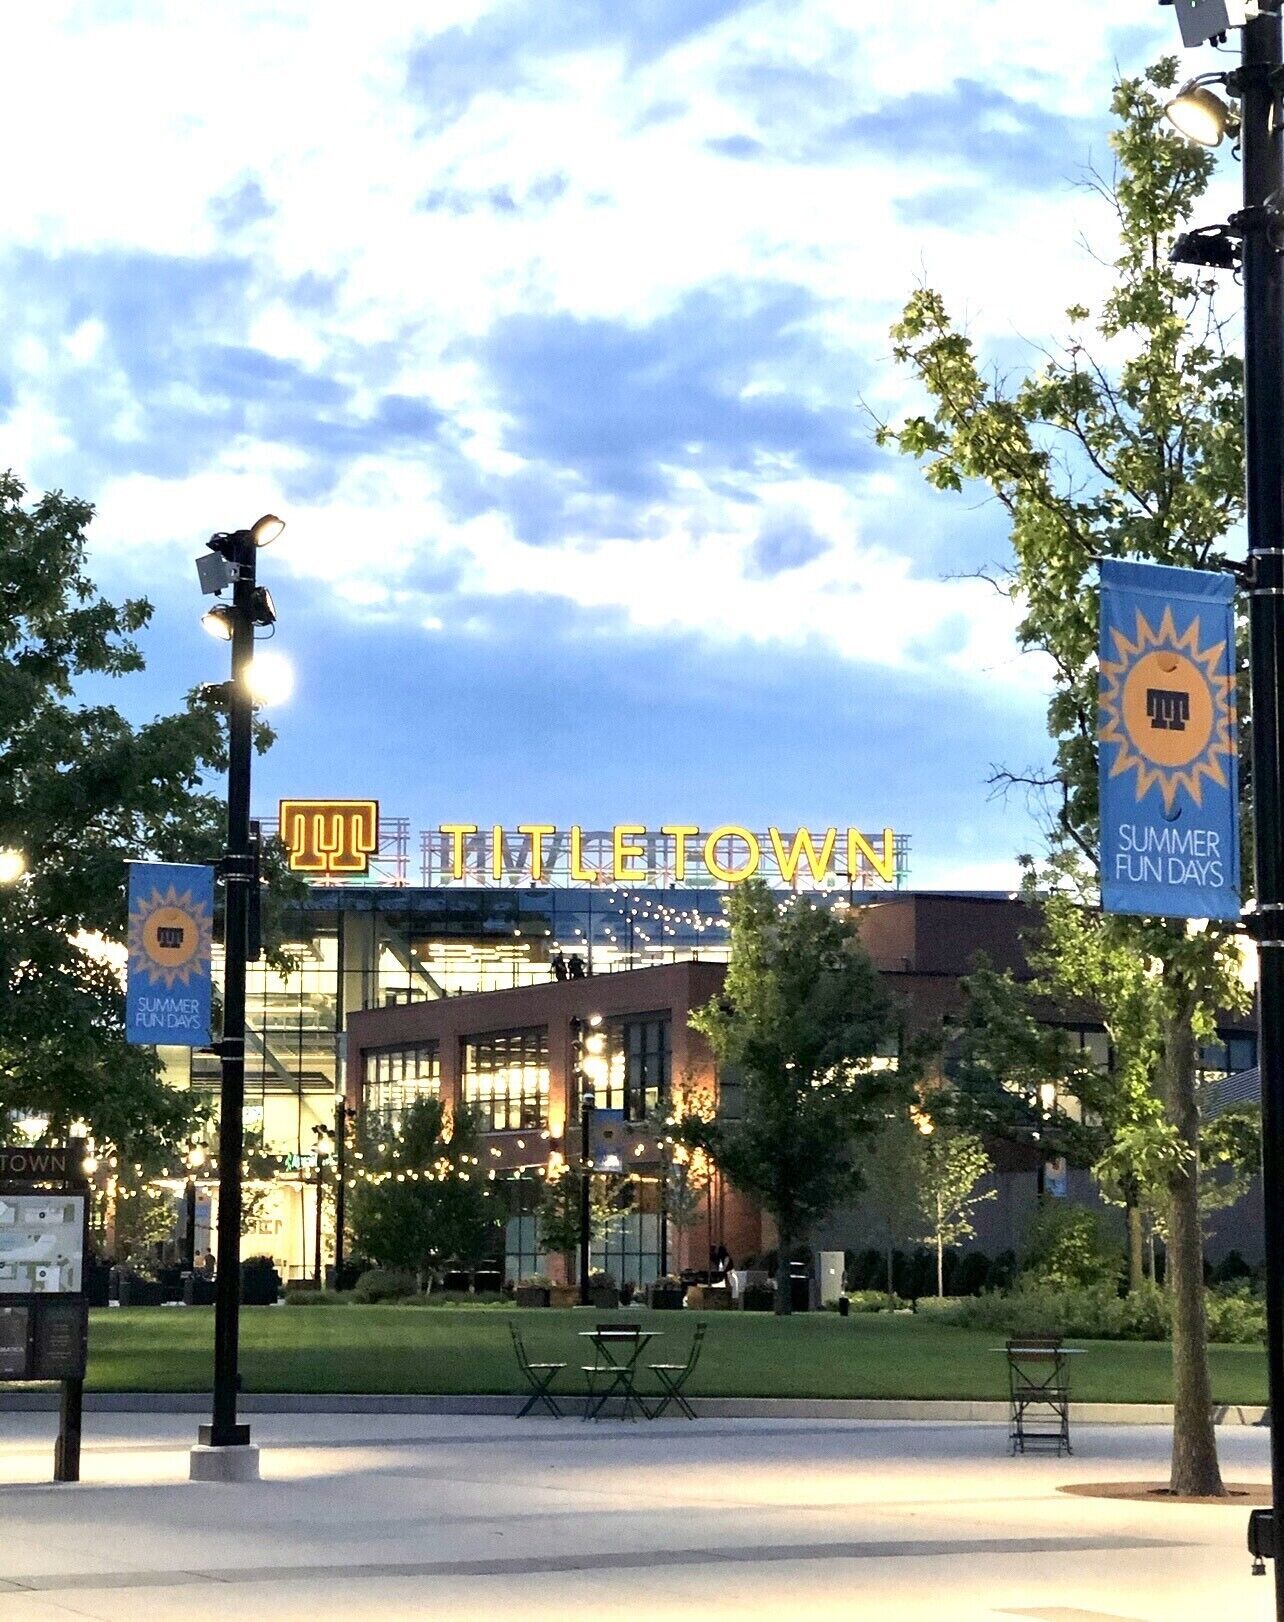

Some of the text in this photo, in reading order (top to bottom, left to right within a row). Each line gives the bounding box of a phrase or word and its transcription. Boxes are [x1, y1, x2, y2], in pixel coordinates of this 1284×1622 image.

[439, 825, 893, 882] TITLETOWN
[1119, 824, 1220, 858] SUMMER
[1116, 853, 1224, 887] FUN DAYS
[138, 997, 199, 1014] SUMMER
[135, 1012, 201, 1029] FUN DAYS
[0, 1154, 66, 1172] TOWN
